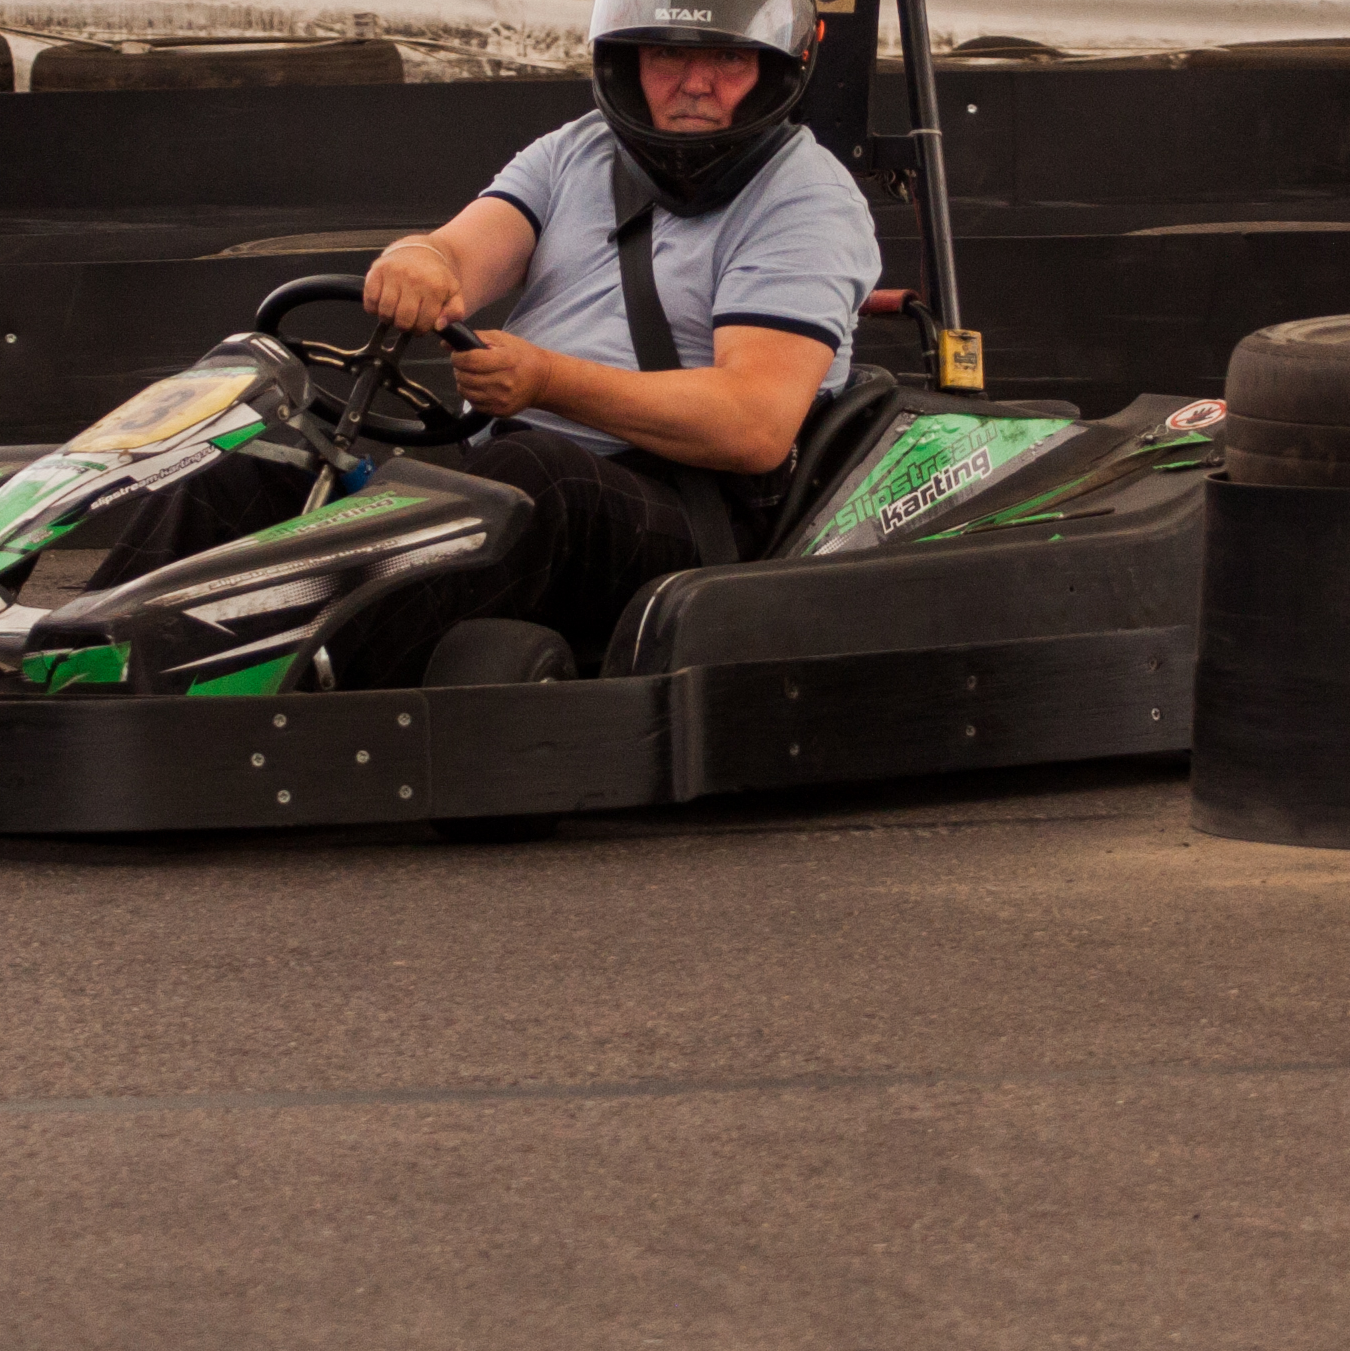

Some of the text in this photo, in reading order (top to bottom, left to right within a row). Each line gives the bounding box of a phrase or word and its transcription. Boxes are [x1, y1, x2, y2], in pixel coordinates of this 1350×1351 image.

[654, 7, 712, 22] ATAKI
[833, 419, 999, 534] Slipstream
[879, 446, 993, 534] karting
